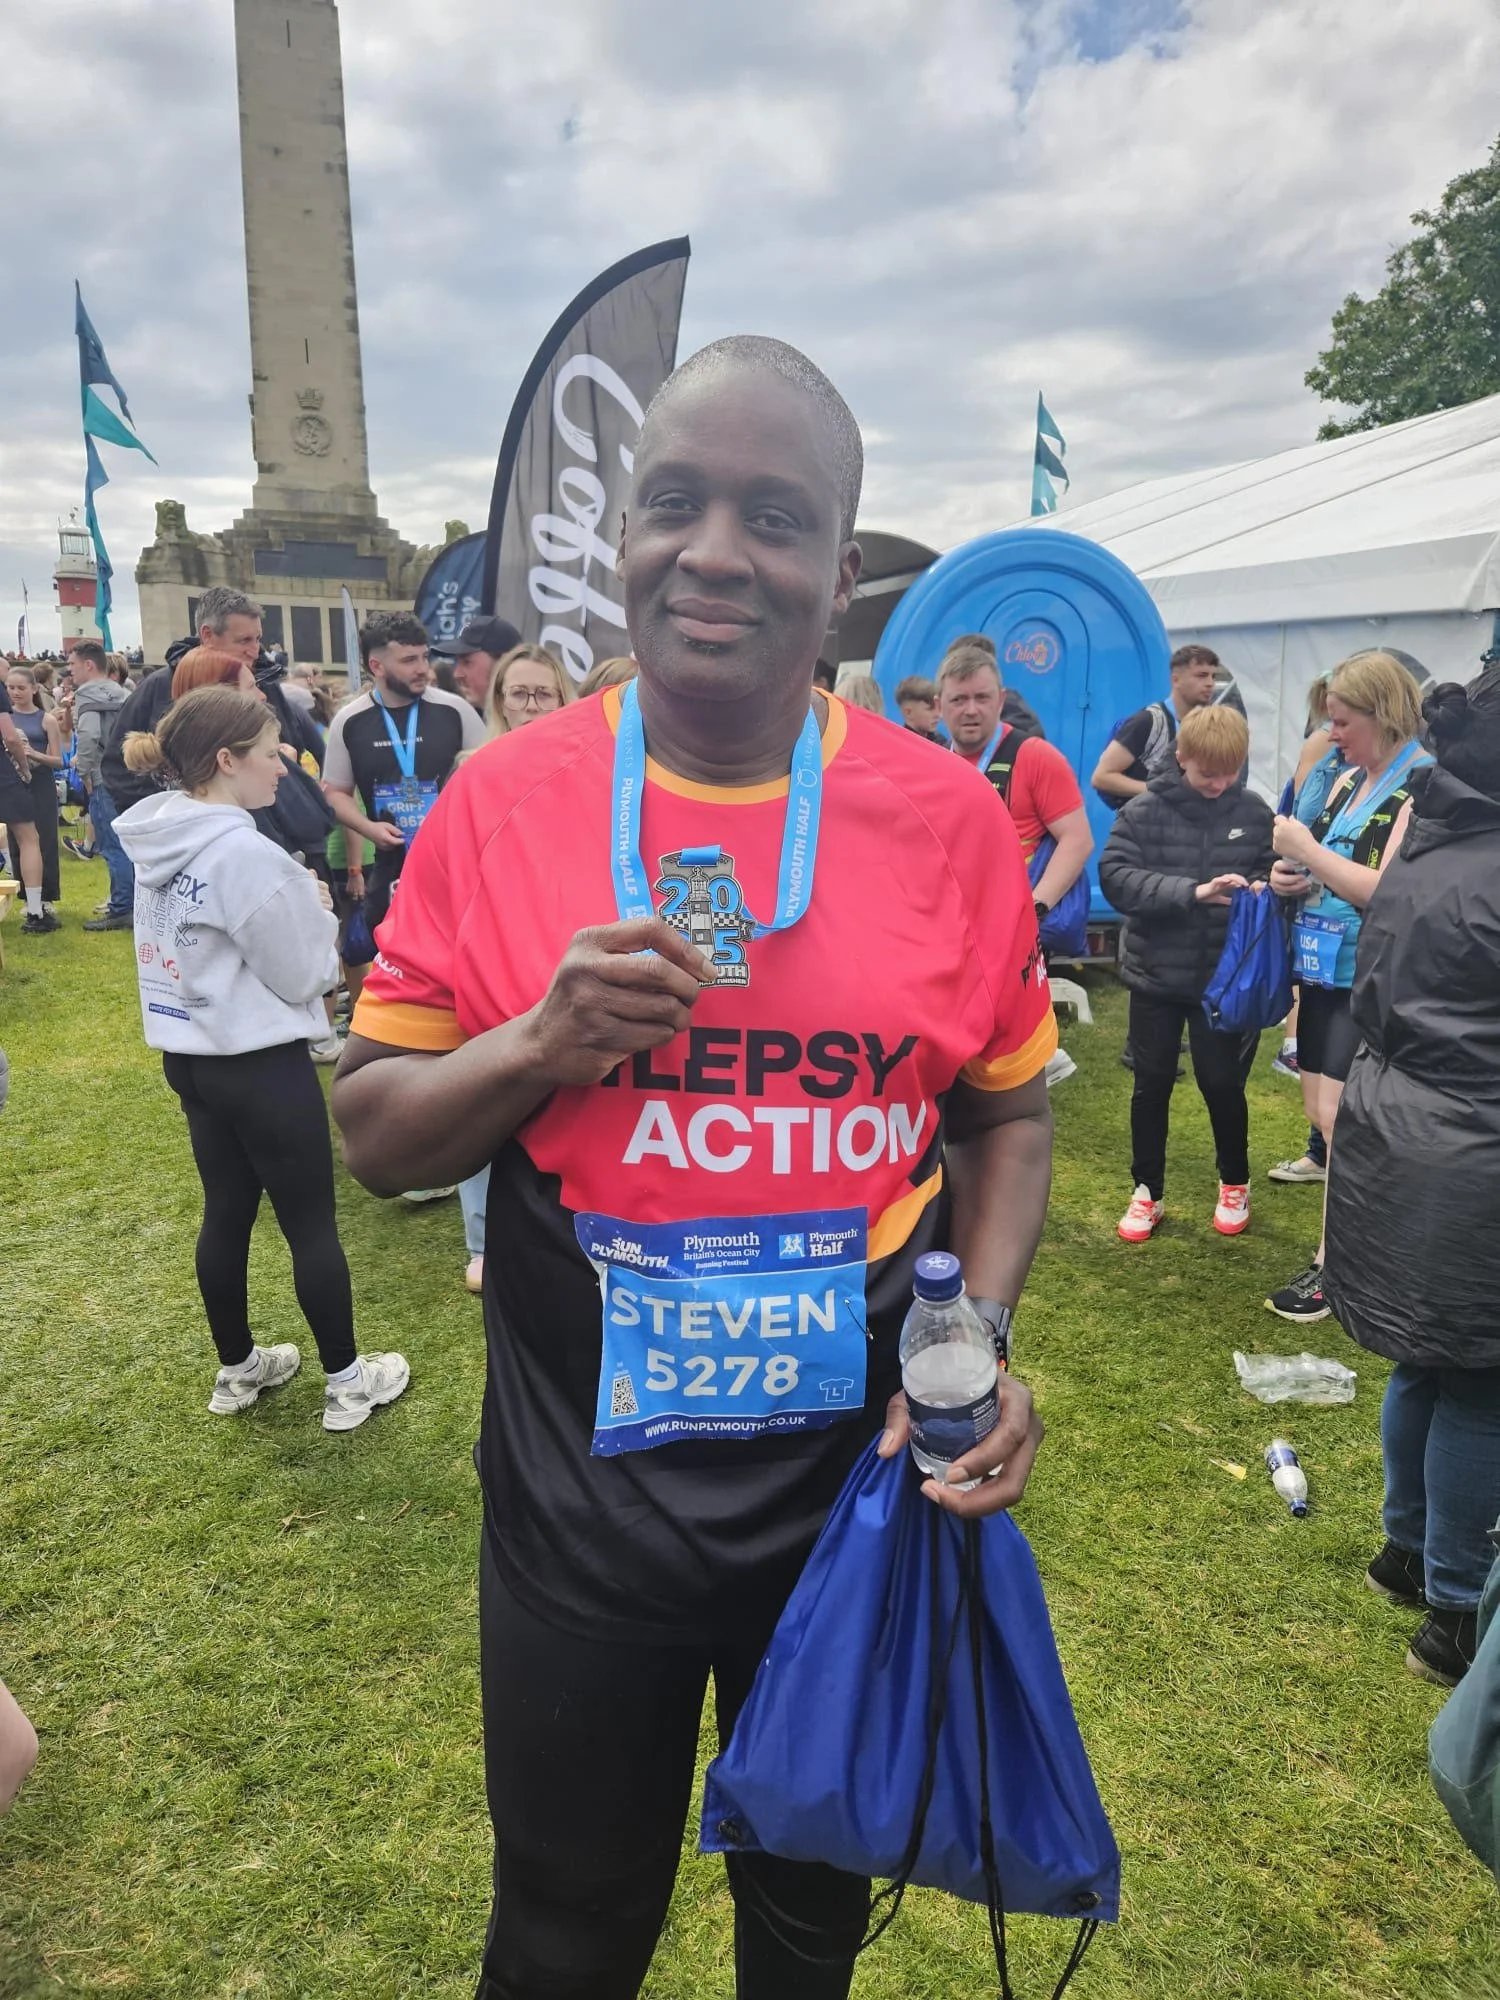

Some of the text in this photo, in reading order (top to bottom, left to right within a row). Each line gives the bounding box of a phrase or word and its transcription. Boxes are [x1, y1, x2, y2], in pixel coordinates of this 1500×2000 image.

[619, 777, 638, 896] PLYMOUTH HALF
[785, 796, 810, 918] PLYMOUTH HALF
[621, 1099, 927, 1174] ACTION
[684, 1232, 760, 1252] Plymouth
[809, 1228, 857, 1243] Plymouth
[591, 1242, 669, 1268] PLYMOUTH
[684, 1248, 760, 1261] Britain's Ocean City
[810, 1242, 843, 1257] Half
[723, 1258, 749, 1267] Festival
[610, 1286, 836, 1340] STEVEN
[645, 1348, 798, 1396] 5278
[645, 1416, 807, 1438] WWW.RUNPLYMOUTH.CO.UK
